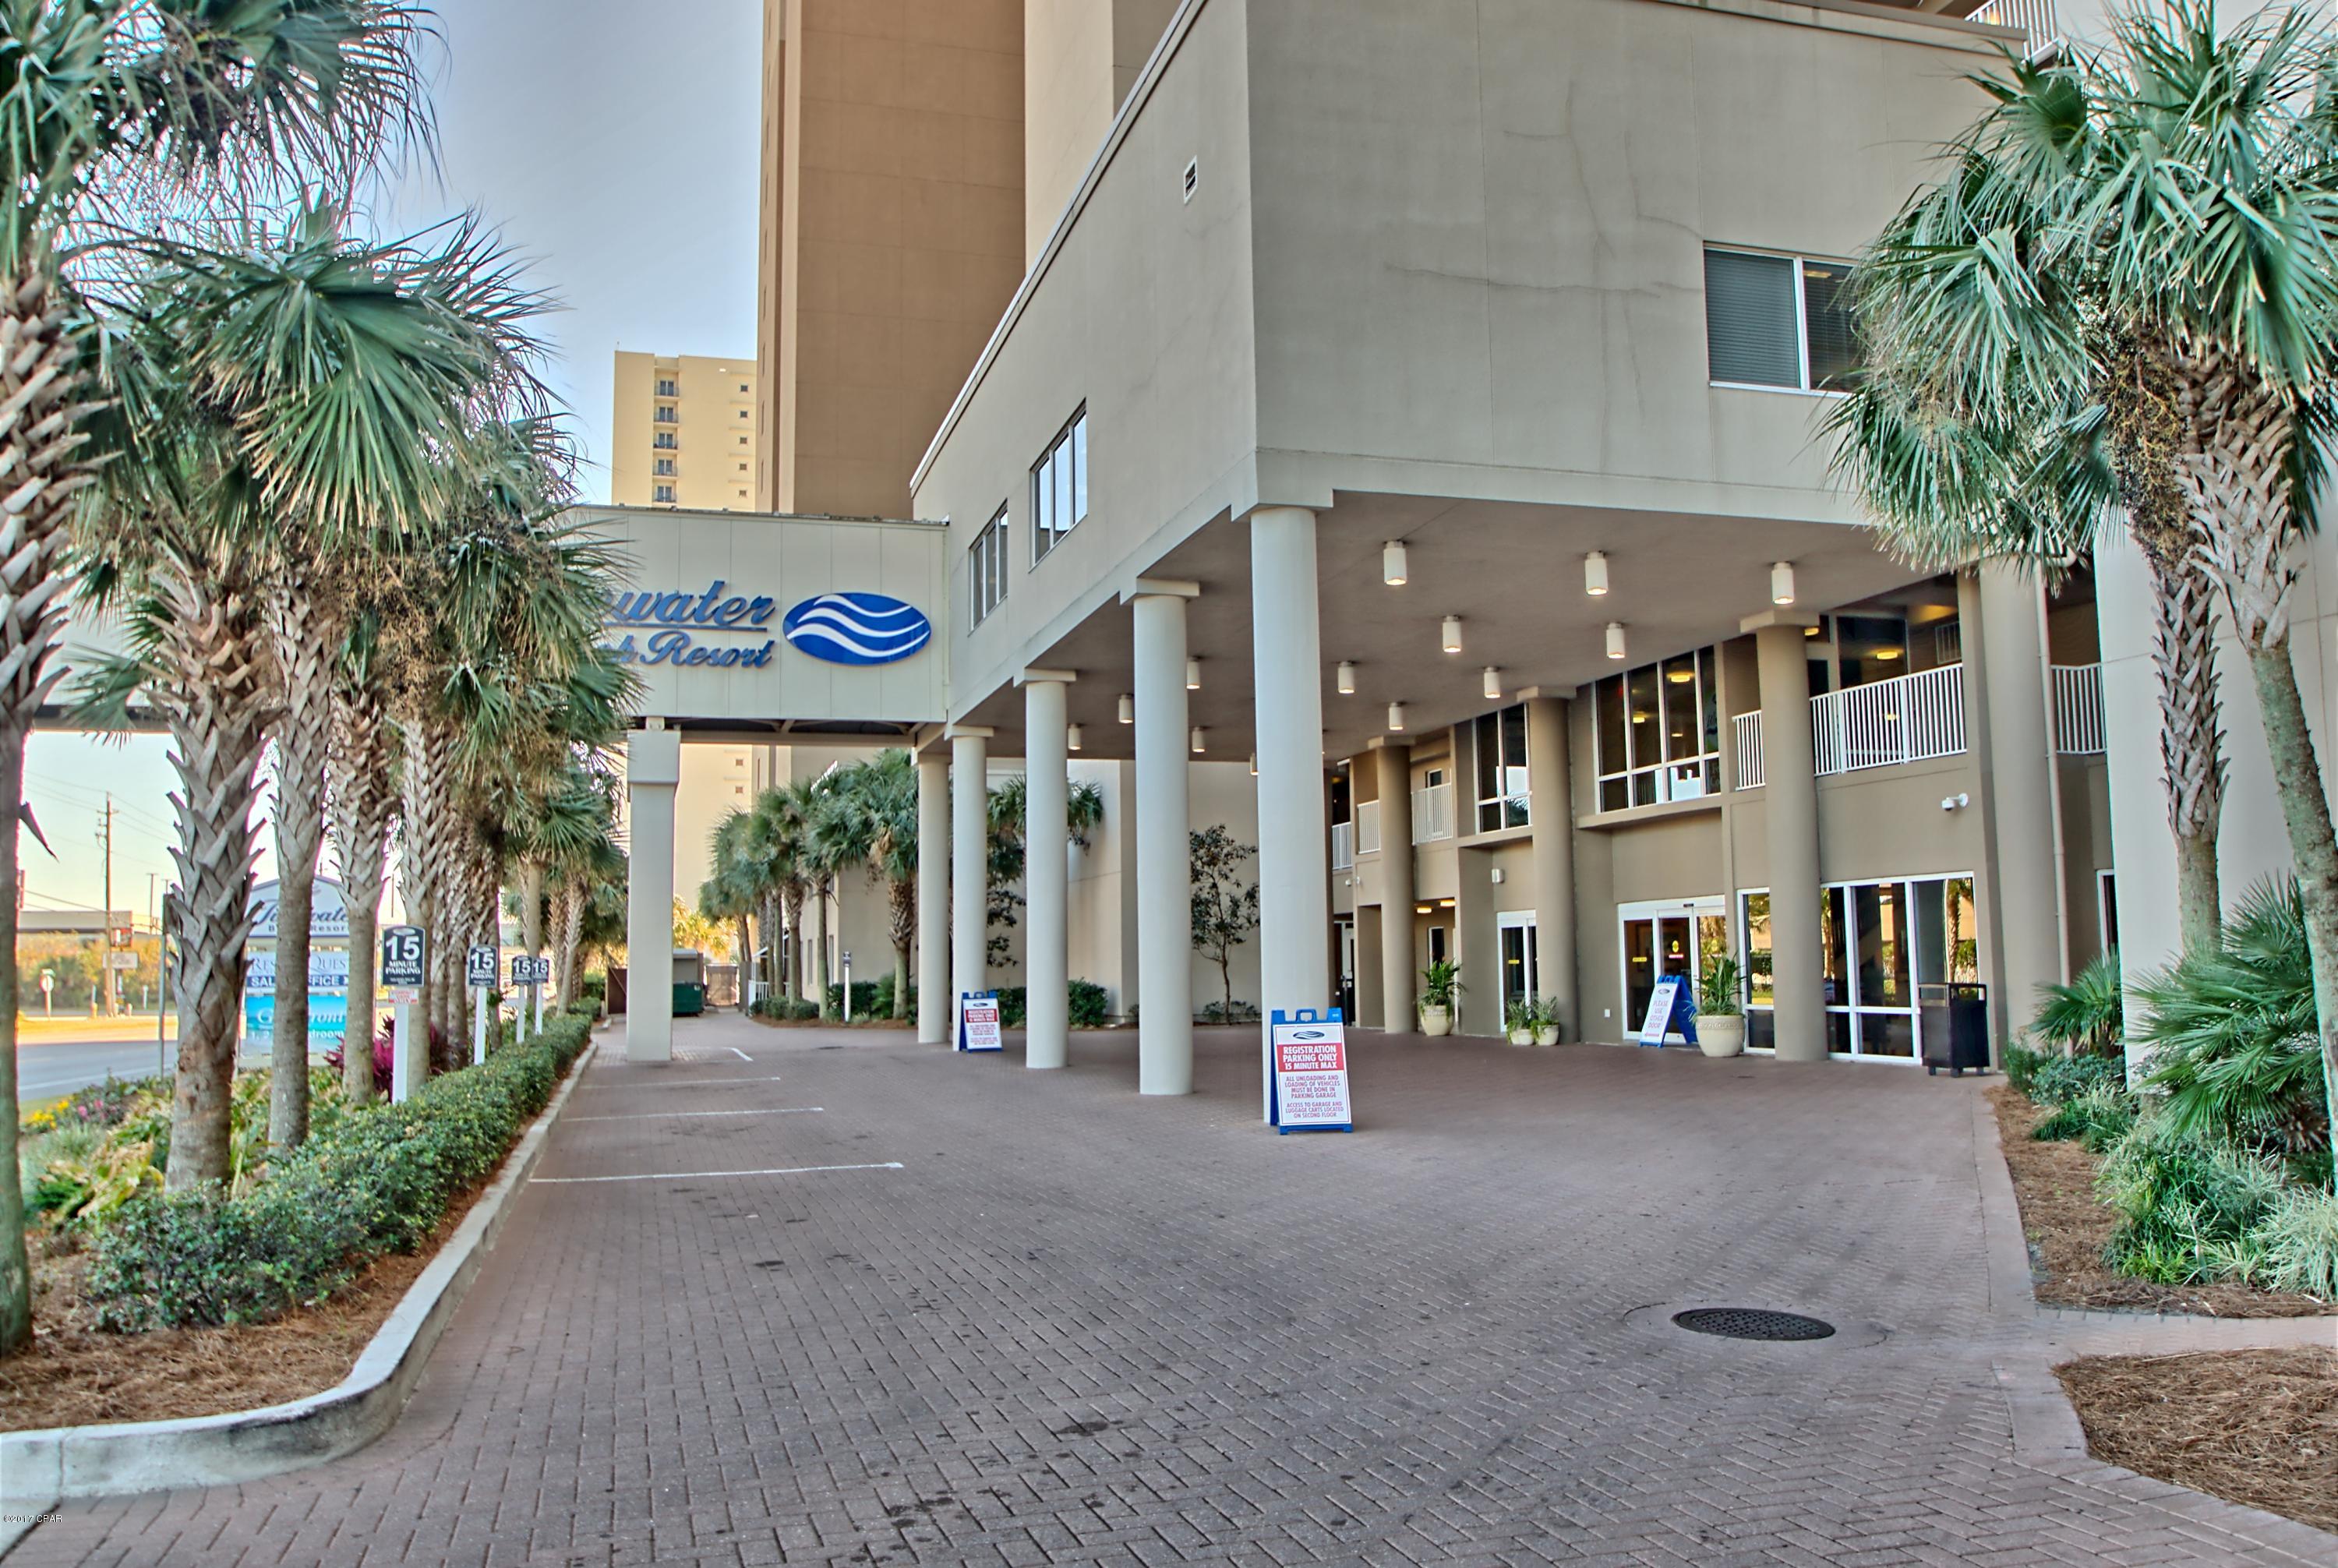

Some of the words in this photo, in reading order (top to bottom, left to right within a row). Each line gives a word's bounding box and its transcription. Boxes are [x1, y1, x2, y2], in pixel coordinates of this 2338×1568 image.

[639, 630, 775, 668] Resort
[386, 935, 420, 960] 15
[471, 952, 494, 969] 15
[514, 960, 531, 973] 15
[533, 962, 548, 973] 15
[1284, 1046, 1337, 1054] REGISTRATION
[1284, 1054, 1316, 1063] PARKING
[1318, 1053, 1337, 1061] ONLY
[1321, 1061, 1338, 1069] MAX
